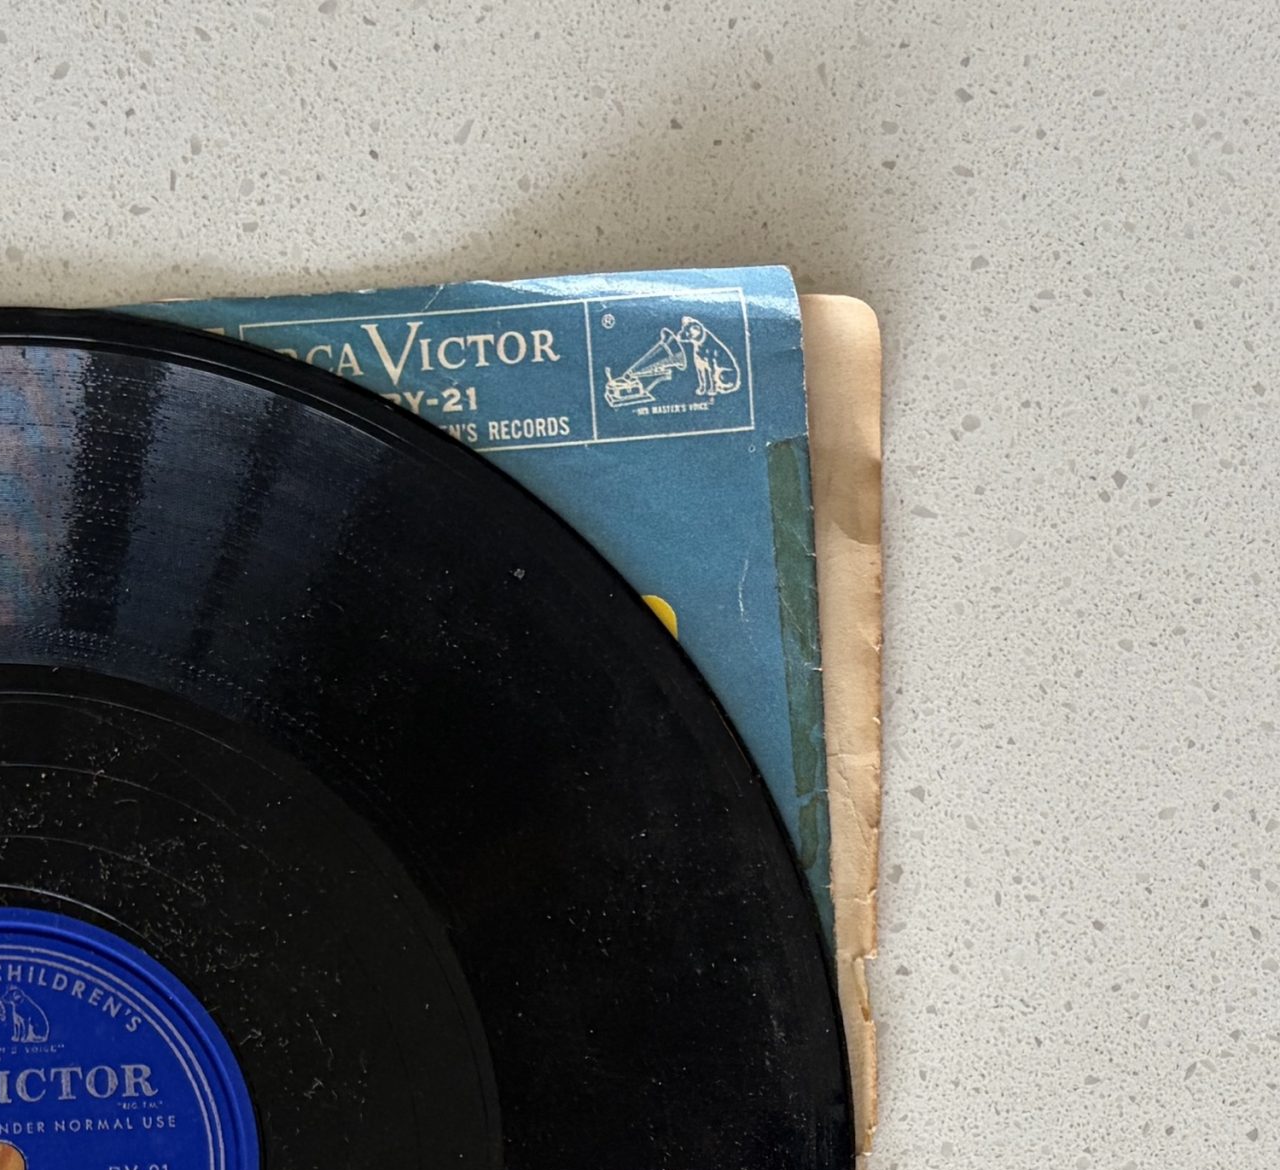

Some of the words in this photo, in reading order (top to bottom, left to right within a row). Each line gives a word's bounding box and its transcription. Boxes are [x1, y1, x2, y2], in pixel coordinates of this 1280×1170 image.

[360, 322, 561, 385] VICTOR
[488, 416, 570, 440] RECORDS
[54, 1117, 134, 1133] NORMAL
[142, 1115, 177, 1130] USE
